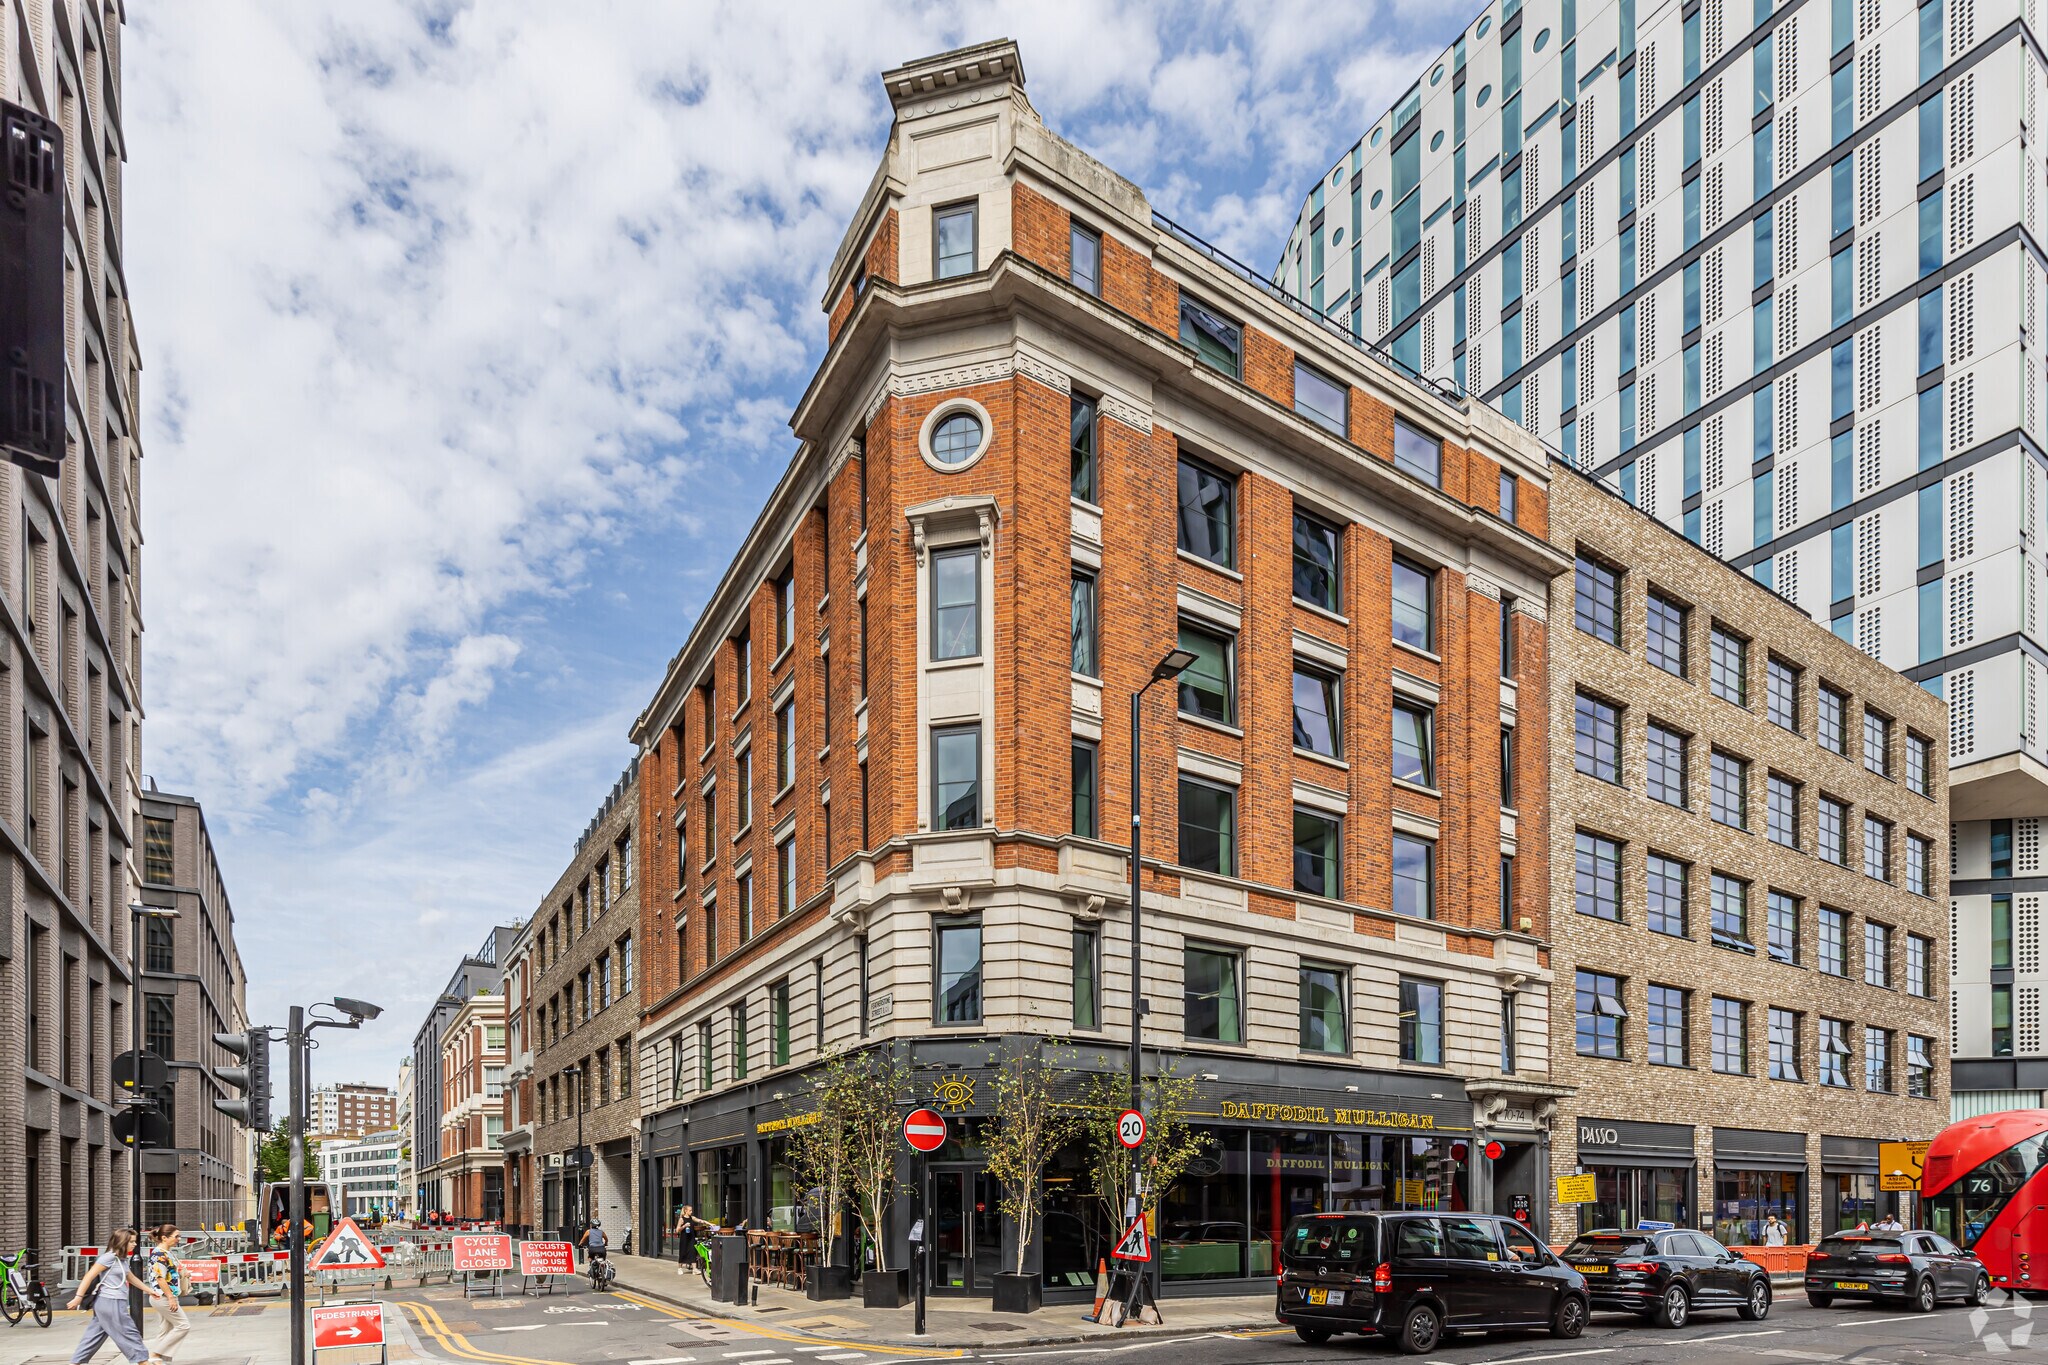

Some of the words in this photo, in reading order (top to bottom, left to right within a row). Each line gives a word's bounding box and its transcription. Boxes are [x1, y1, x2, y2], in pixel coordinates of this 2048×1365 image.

[1221, 1101, 1329, 1123] DAFFODIL
[1334, 1108, 1435, 1129] MULLIGAN
[1504, 1108, 1525, 1121] 70-74
[1121, 1121, 1141, 1137] 20
[1581, 1126, 1618, 1145] PASSO
[1266, 1159, 1325, 1169] DAFFODIL
[1333, 1160, 1390, 1170] MULLIGAN
[1971, 1180, 1991, 1192] 76
[464, 1237, 500, 1246] CYCLE
[468, 1248, 498, 1256] LANE
[460, 1258, 507, 1268] CLOSED
[315, 1309, 380, 1321] PEDESTRIANS
